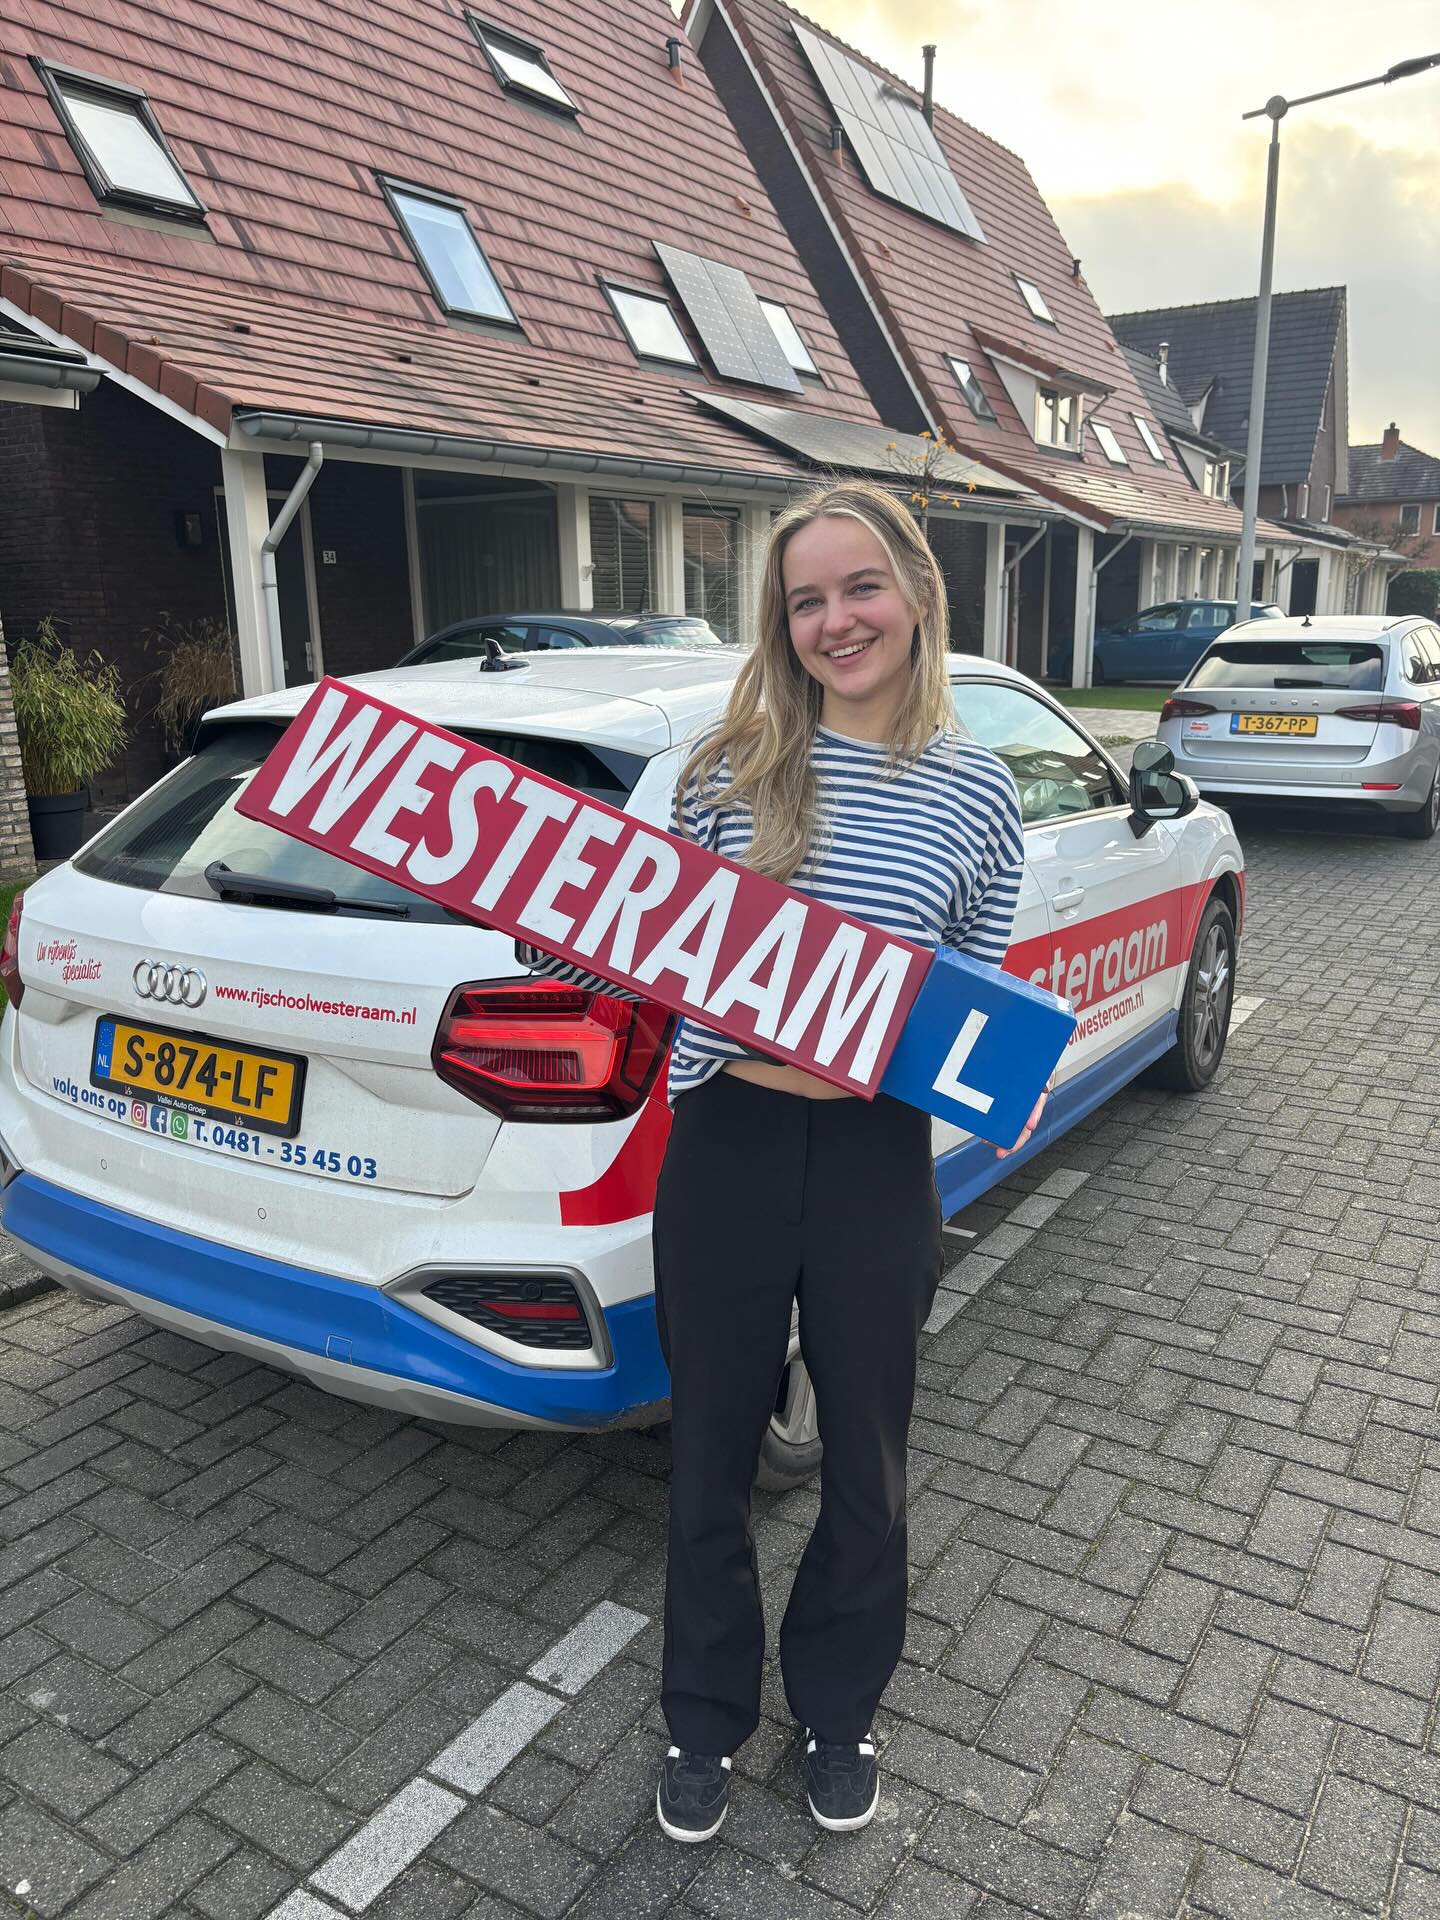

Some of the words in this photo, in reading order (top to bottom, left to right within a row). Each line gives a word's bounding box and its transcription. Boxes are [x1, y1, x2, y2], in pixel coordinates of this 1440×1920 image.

[1243, 716, 1308, 731] T-367-PP
[268, 687, 914, 1085] WESTERAAM
[63, 957, 102, 984] specialist
[215, 985, 417, 1025] www.rijschoolwesteraam.nl
[97, 1053, 109, 1068] NL
[123, 1034, 278, 1110] S-874-LF
[931, 1008, 996, 1115] L
[53, 1077, 78, 1103] volg
[81, 1087, 104, 1109] ons
[107, 1098, 127, 1119] op
[157, 1095, 172, 1106] Vallei
[173, 1100, 188, 1110] Auto
[188, 1104, 207, 1116] Groep
[193, 1119, 208, 1143] T.
[212, 1126, 260, 1155] 0481
[280, 1142, 307, 1165] 35
[312, 1149, 341, 1173] 45
[347, 1155, 377, 1179] 03
